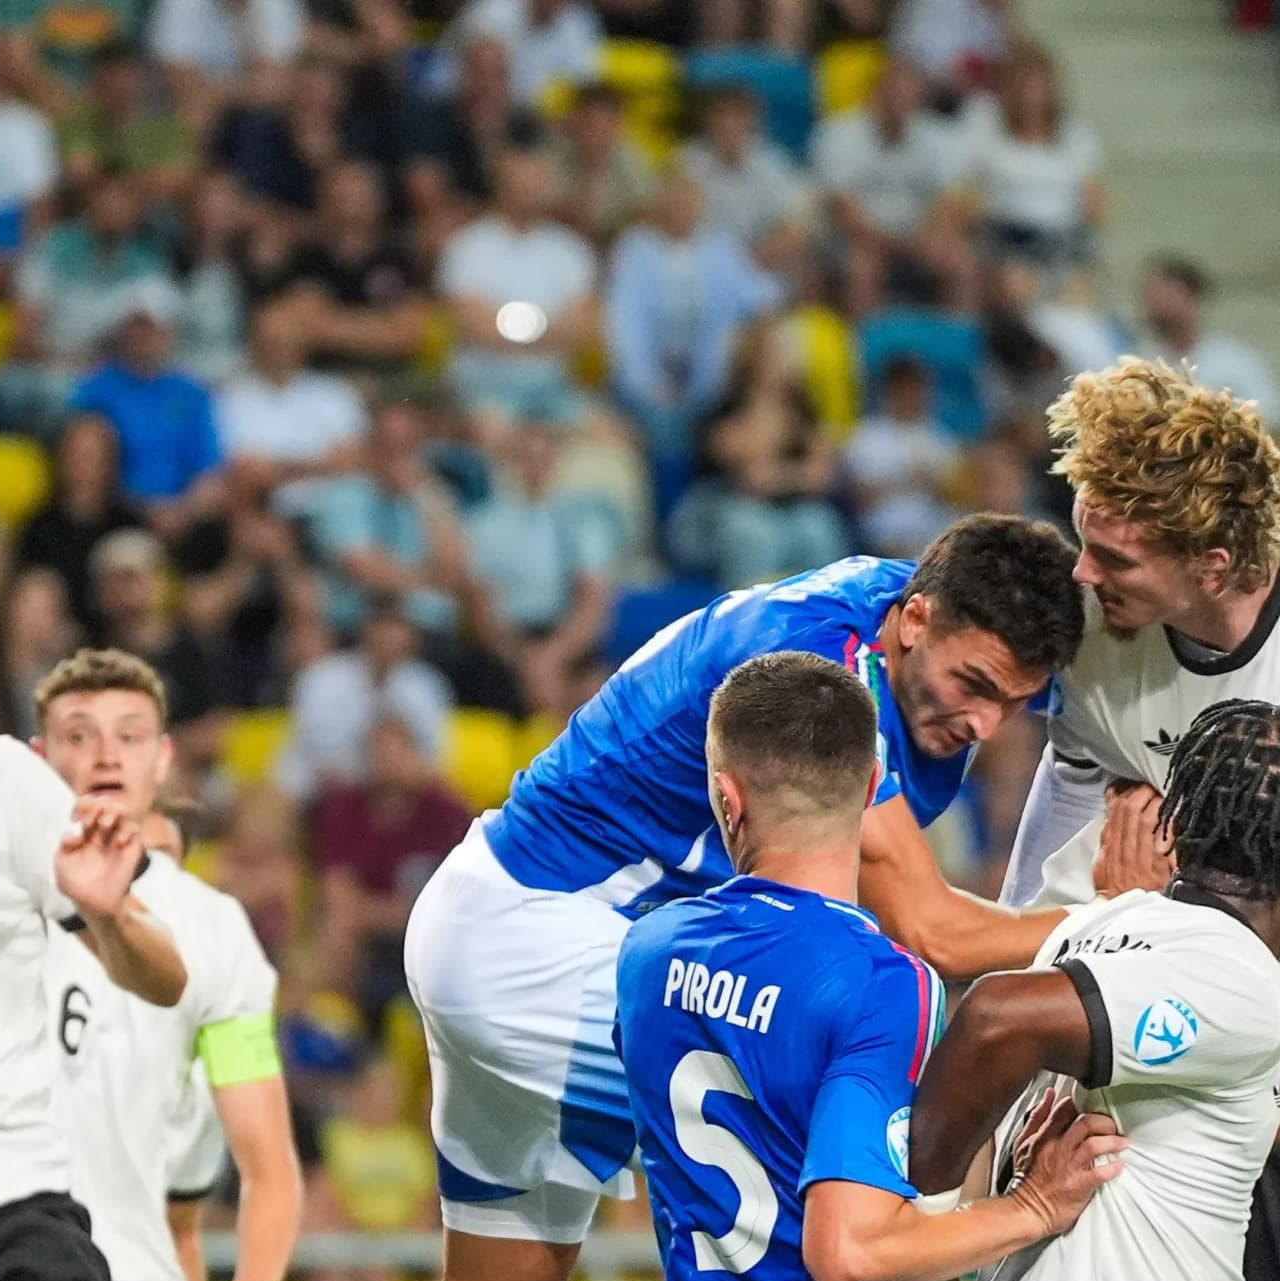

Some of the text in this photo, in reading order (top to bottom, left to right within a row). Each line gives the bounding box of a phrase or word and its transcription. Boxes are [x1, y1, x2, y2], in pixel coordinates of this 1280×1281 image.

[58, 984, 91, 1056] 6
[663, 958, 781, 1034] PIROLA
[669, 1049, 779, 1274] 5
